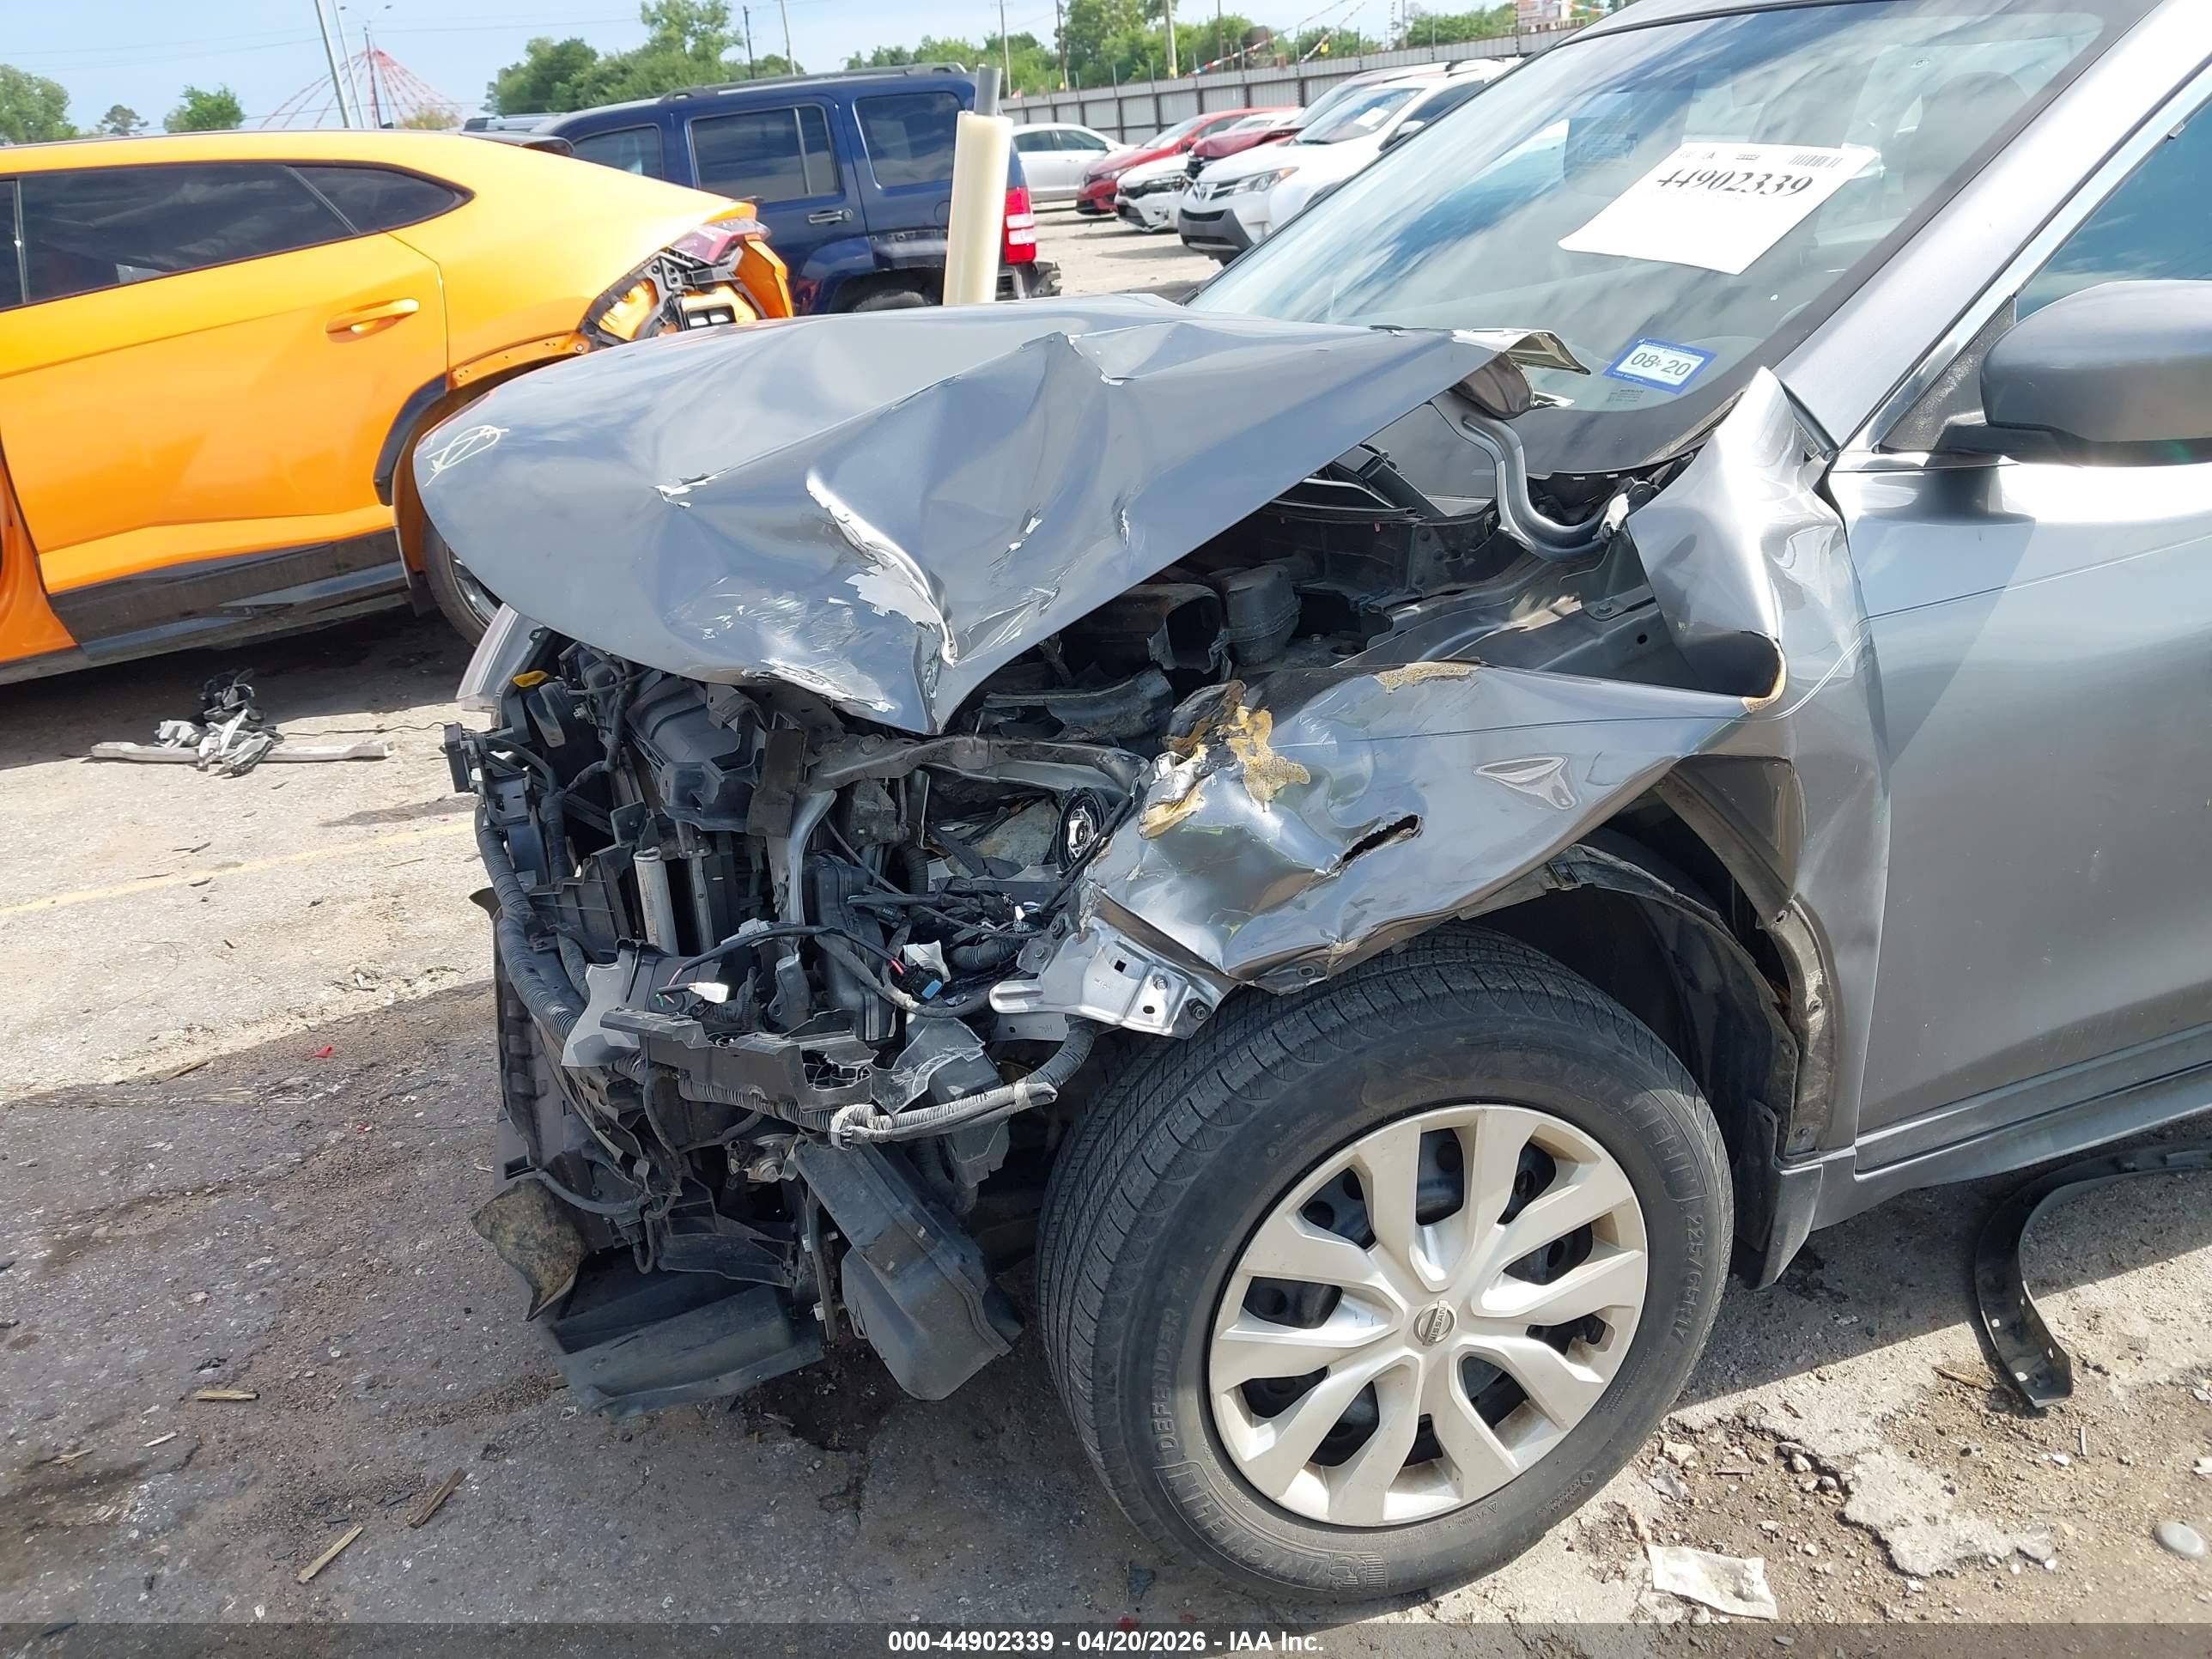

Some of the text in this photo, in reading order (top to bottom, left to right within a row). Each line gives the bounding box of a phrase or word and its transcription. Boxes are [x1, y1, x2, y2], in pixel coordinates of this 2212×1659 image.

[1656, 168, 1814, 197] 44902339
[1632, 352, 1692, 376] 08 20
[1427, 1306, 1447, 1346] NISSAN
[1152, 1307, 1182, 1453] DEFENDER
